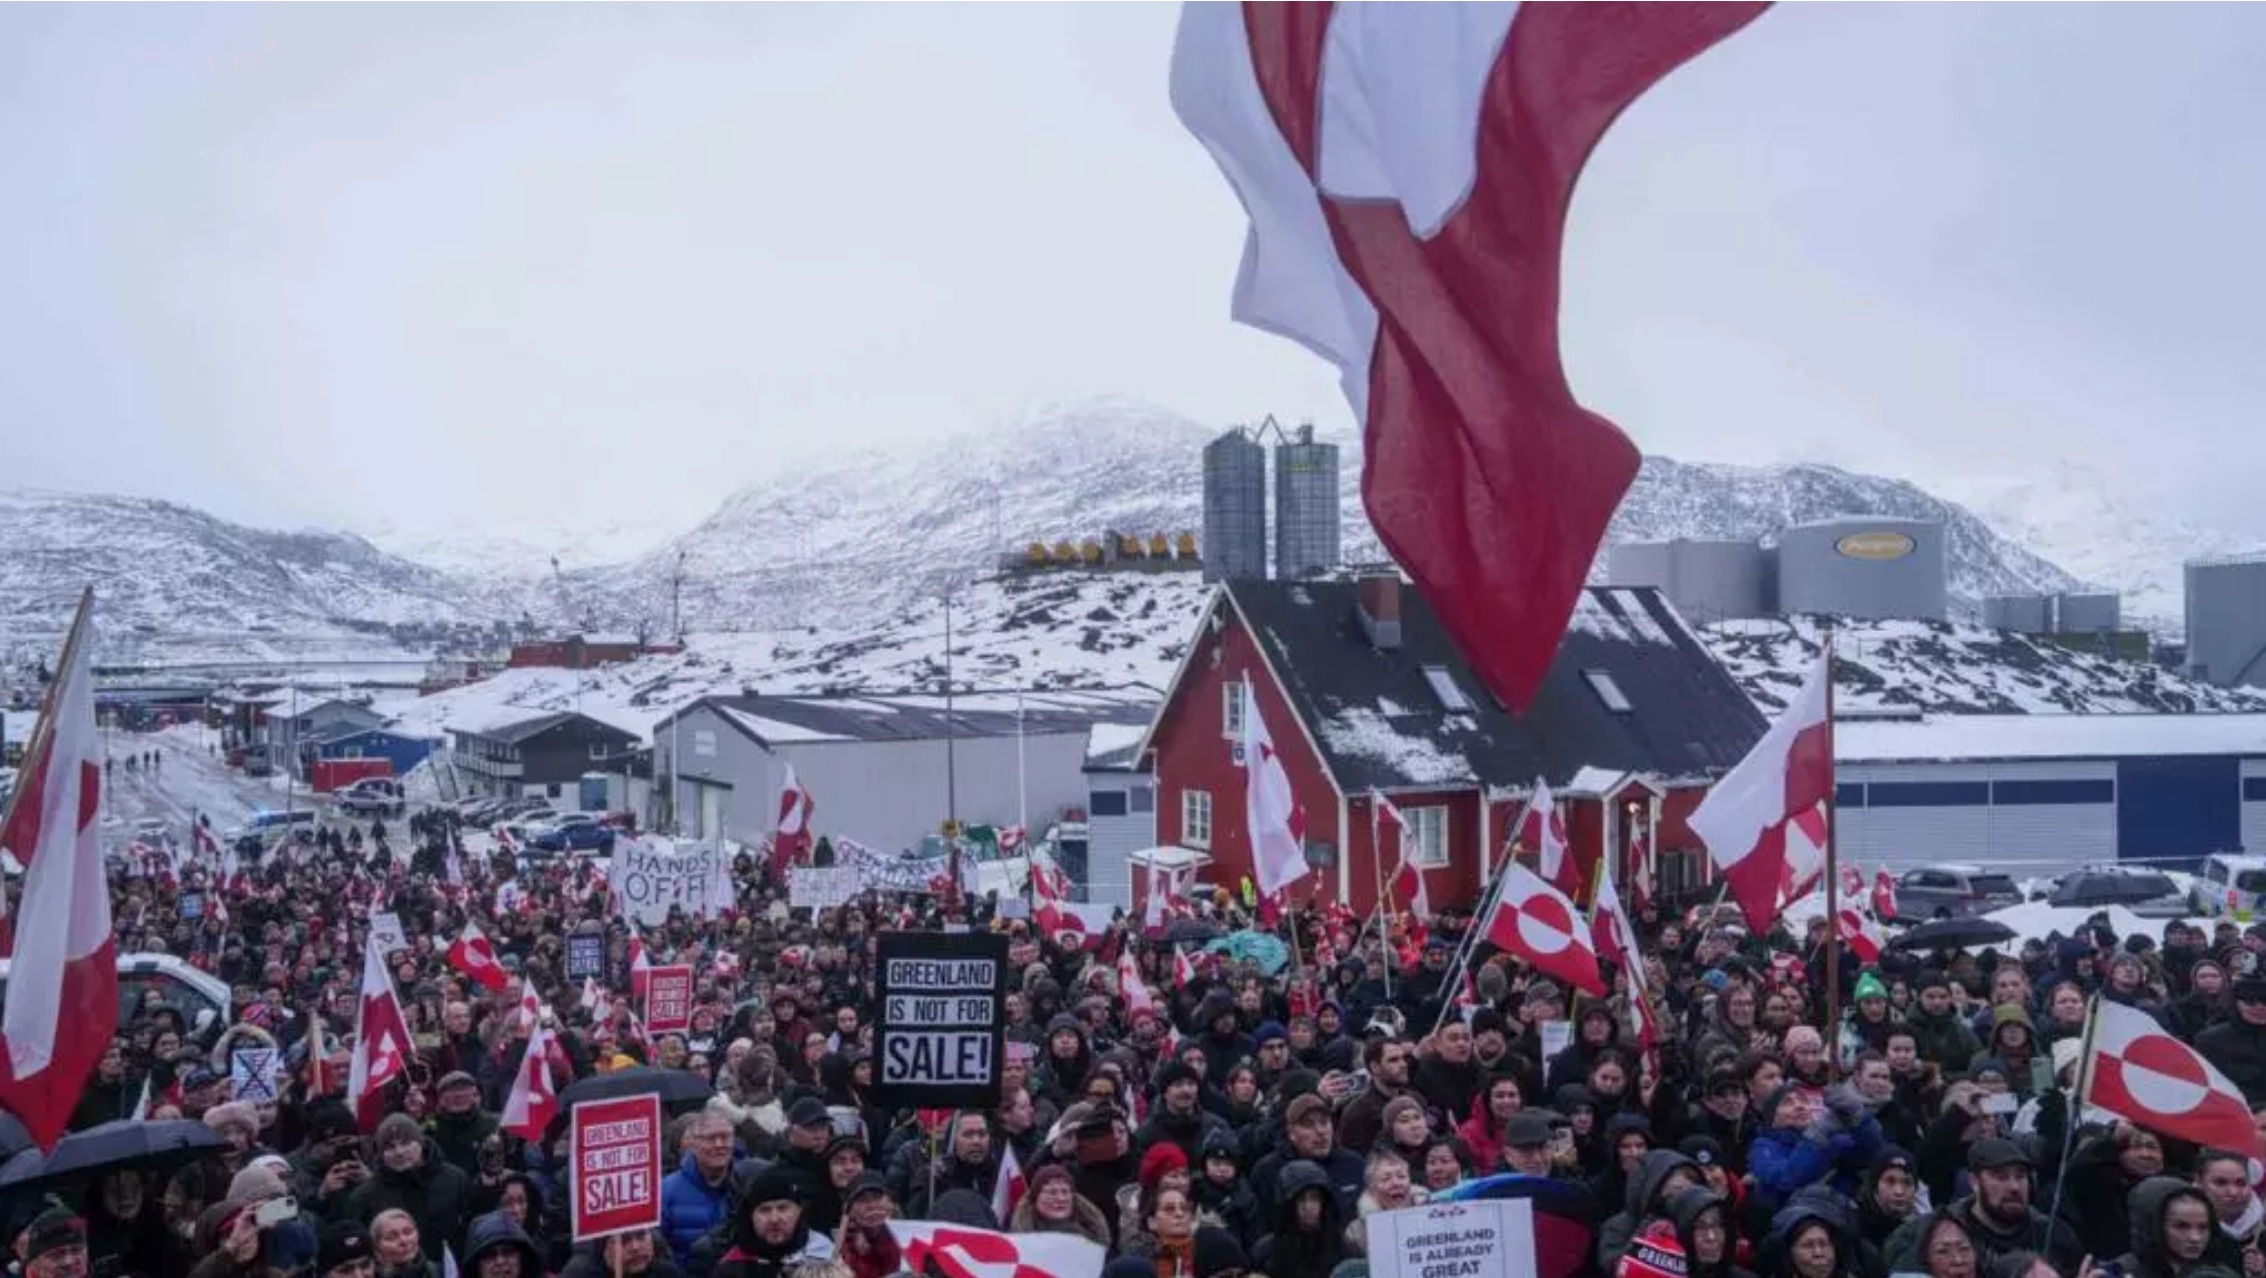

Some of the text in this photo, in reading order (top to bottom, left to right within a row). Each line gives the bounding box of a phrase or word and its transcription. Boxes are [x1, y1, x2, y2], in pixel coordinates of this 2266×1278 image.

[626, 850, 711, 873] HANDS
[625, 872, 705, 904] OFF
[891, 961, 992, 985] GREENLAND
[889, 998, 990, 1022] IS NOT FOR
[887, 1035, 989, 1080] SALE!
[586, 1121, 647, 1143] GREENLAND
[586, 1145, 648, 1168] IS NOT FOR
[587, 1170, 648, 1212] SALE!
[1406, 1228, 1495, 1249] GREENLAND
[1409, 1243, 1495, 1264] IS ALREADY
[1422, 1259, 1482, 1278] GREAT
